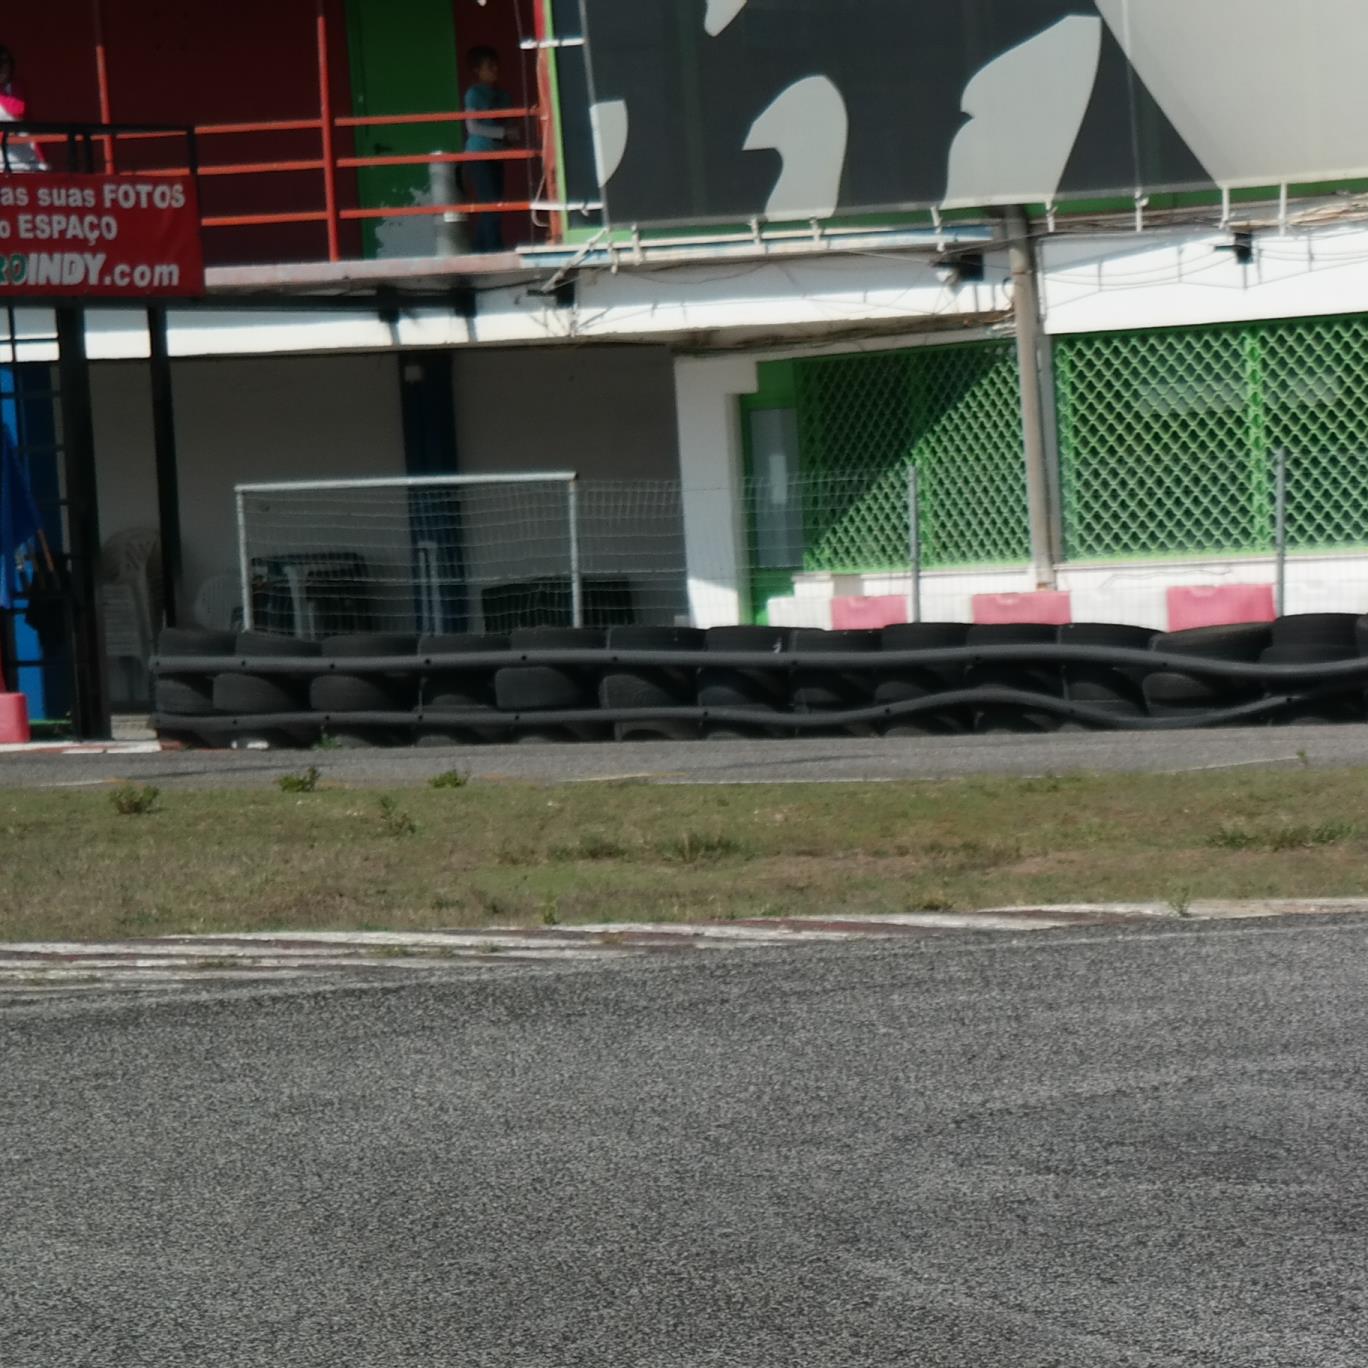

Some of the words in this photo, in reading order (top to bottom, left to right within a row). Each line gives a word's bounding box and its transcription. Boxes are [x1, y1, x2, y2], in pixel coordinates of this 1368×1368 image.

[37, 187, 95, 208] suas
[103, 183, 186, 209] FOTOS
[18, 214, 118, 246] ESPAÇO
